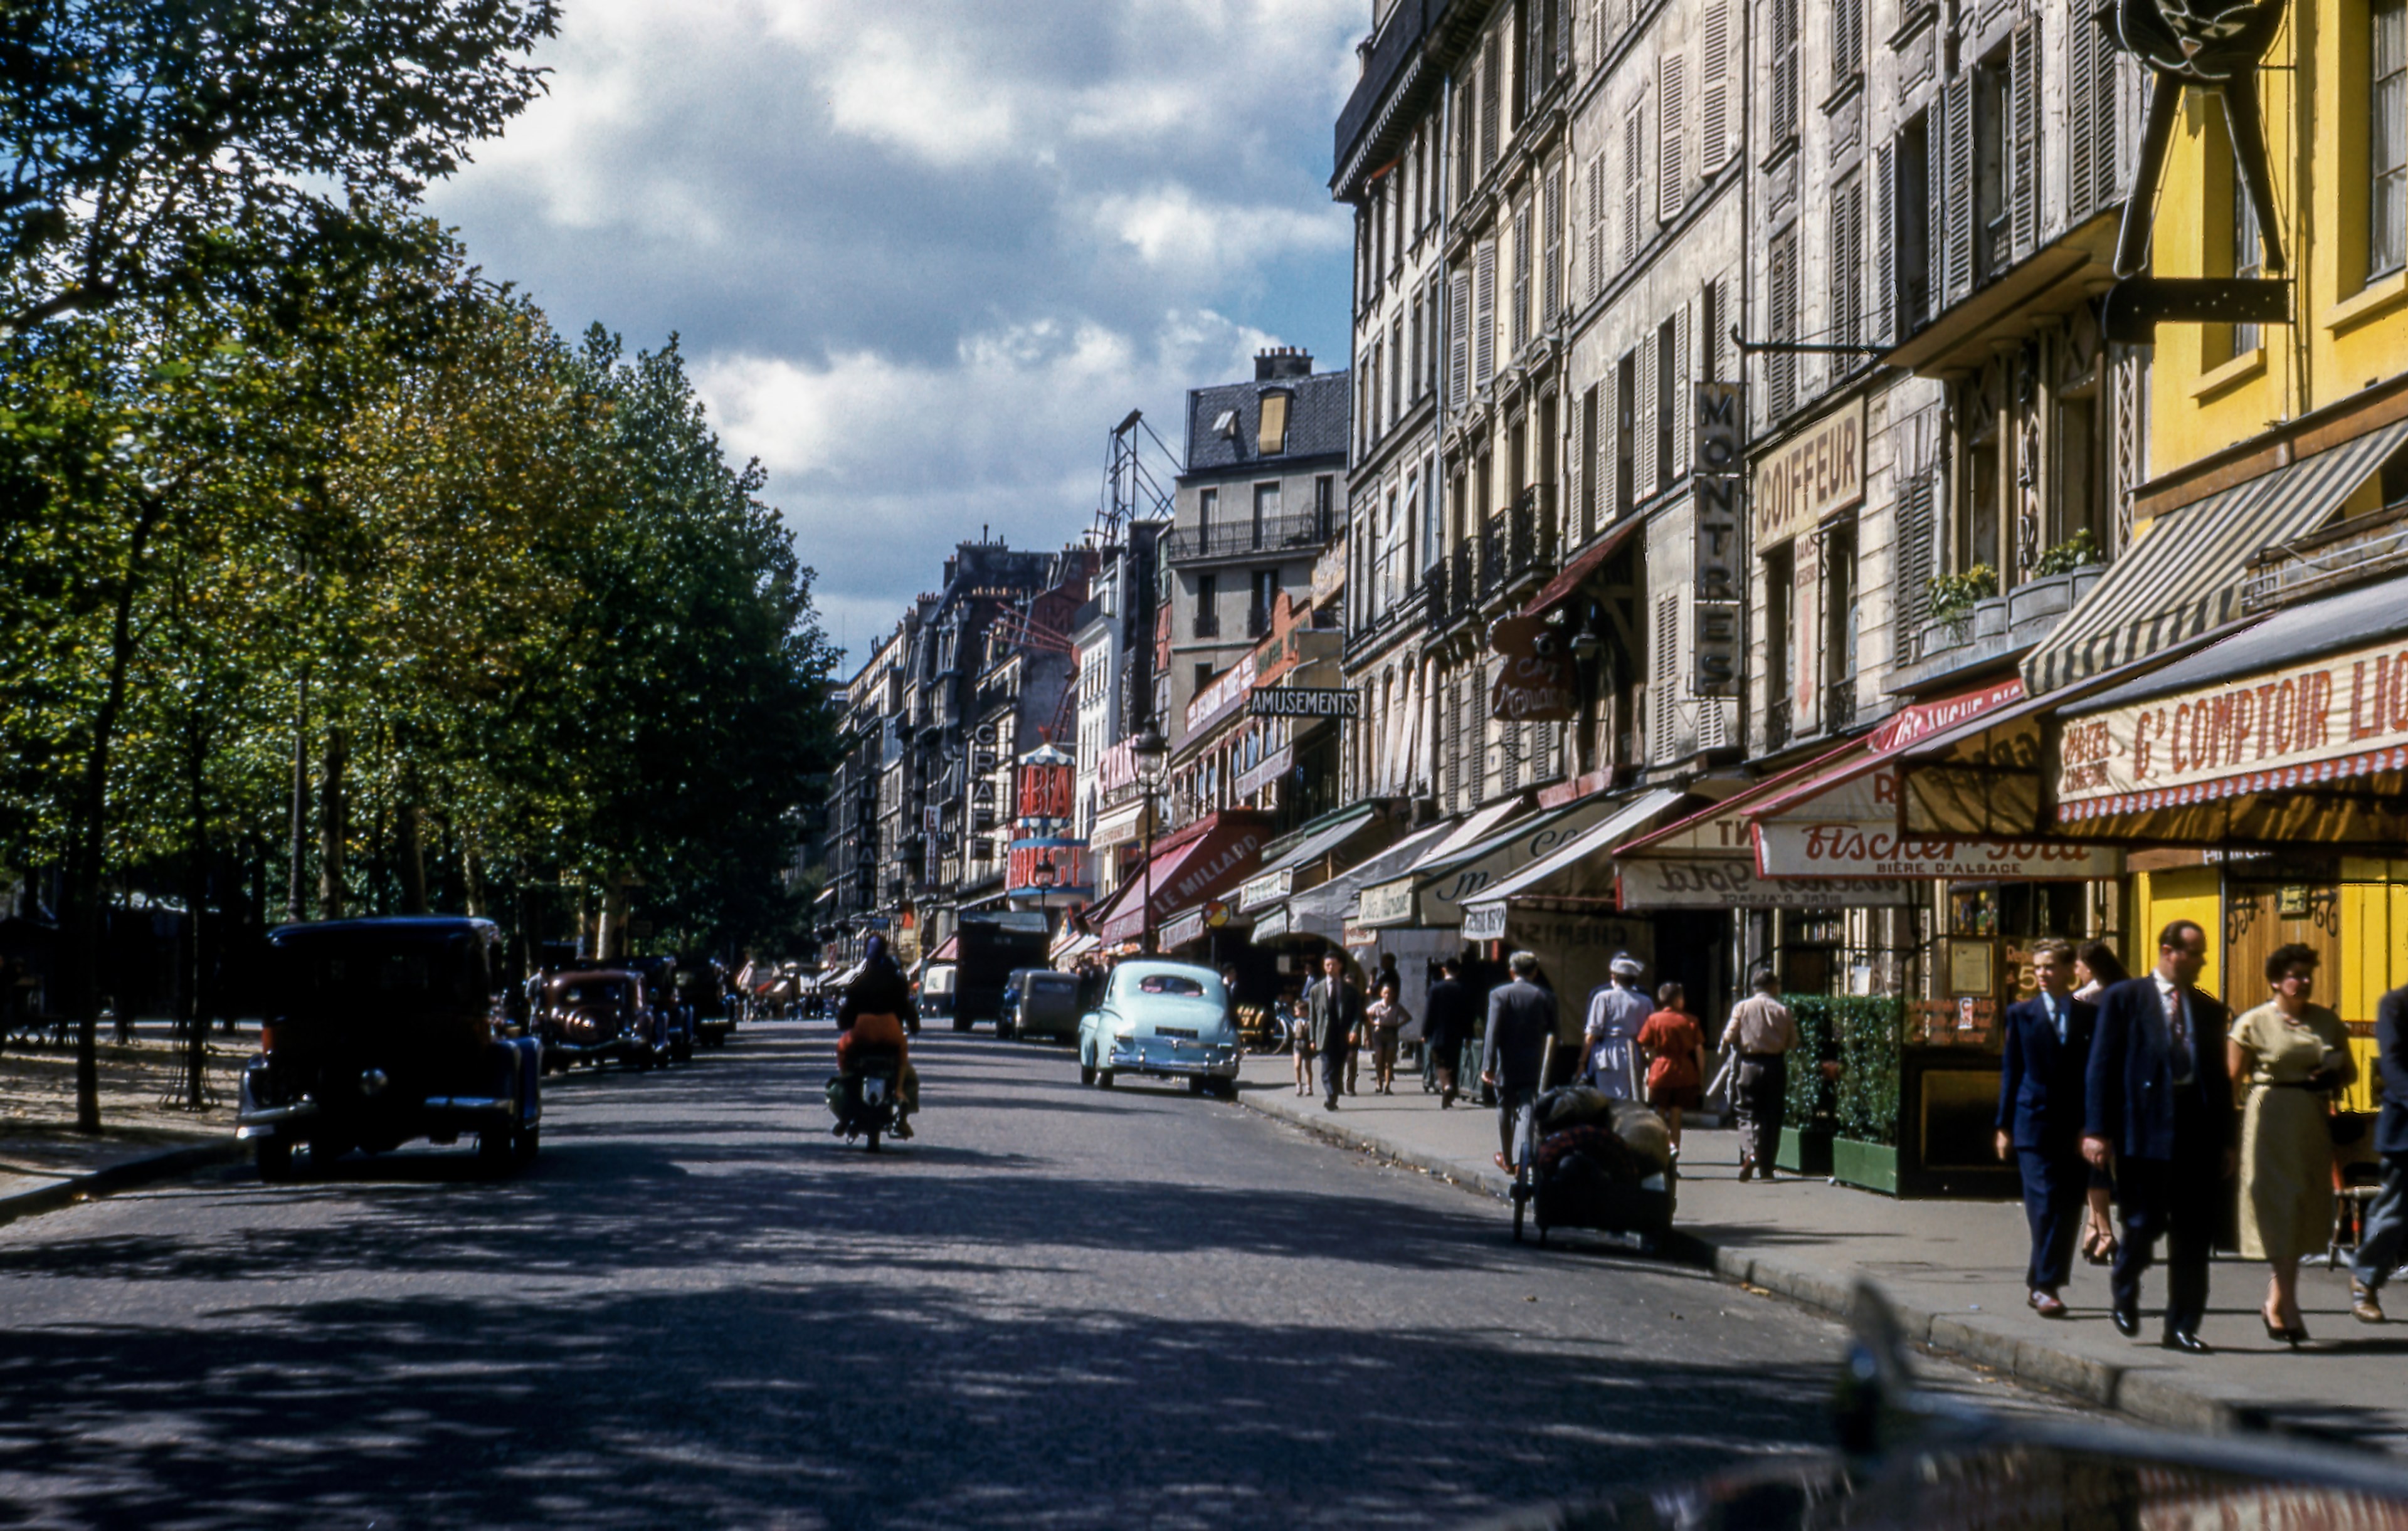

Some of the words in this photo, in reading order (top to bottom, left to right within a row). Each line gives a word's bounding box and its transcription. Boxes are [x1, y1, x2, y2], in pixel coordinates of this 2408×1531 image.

[1760, 416, 1856, 533] COIFFEUR
[1699, 393, 1735, 687] MONTRES
[1251, 690, 1357, 715] AMUSEMENTS
[2171, 670, 2331, 775] COMPTOIR
[973, 723, 996, 858] GRAFF
[1154, 890, 1179, 913] LE
[1178, 834, 1258, 897] MILLARD
[1876, 861, 1925, 873] BIÈRE
[1935, 862, 2022, 874] D'ALSACE
